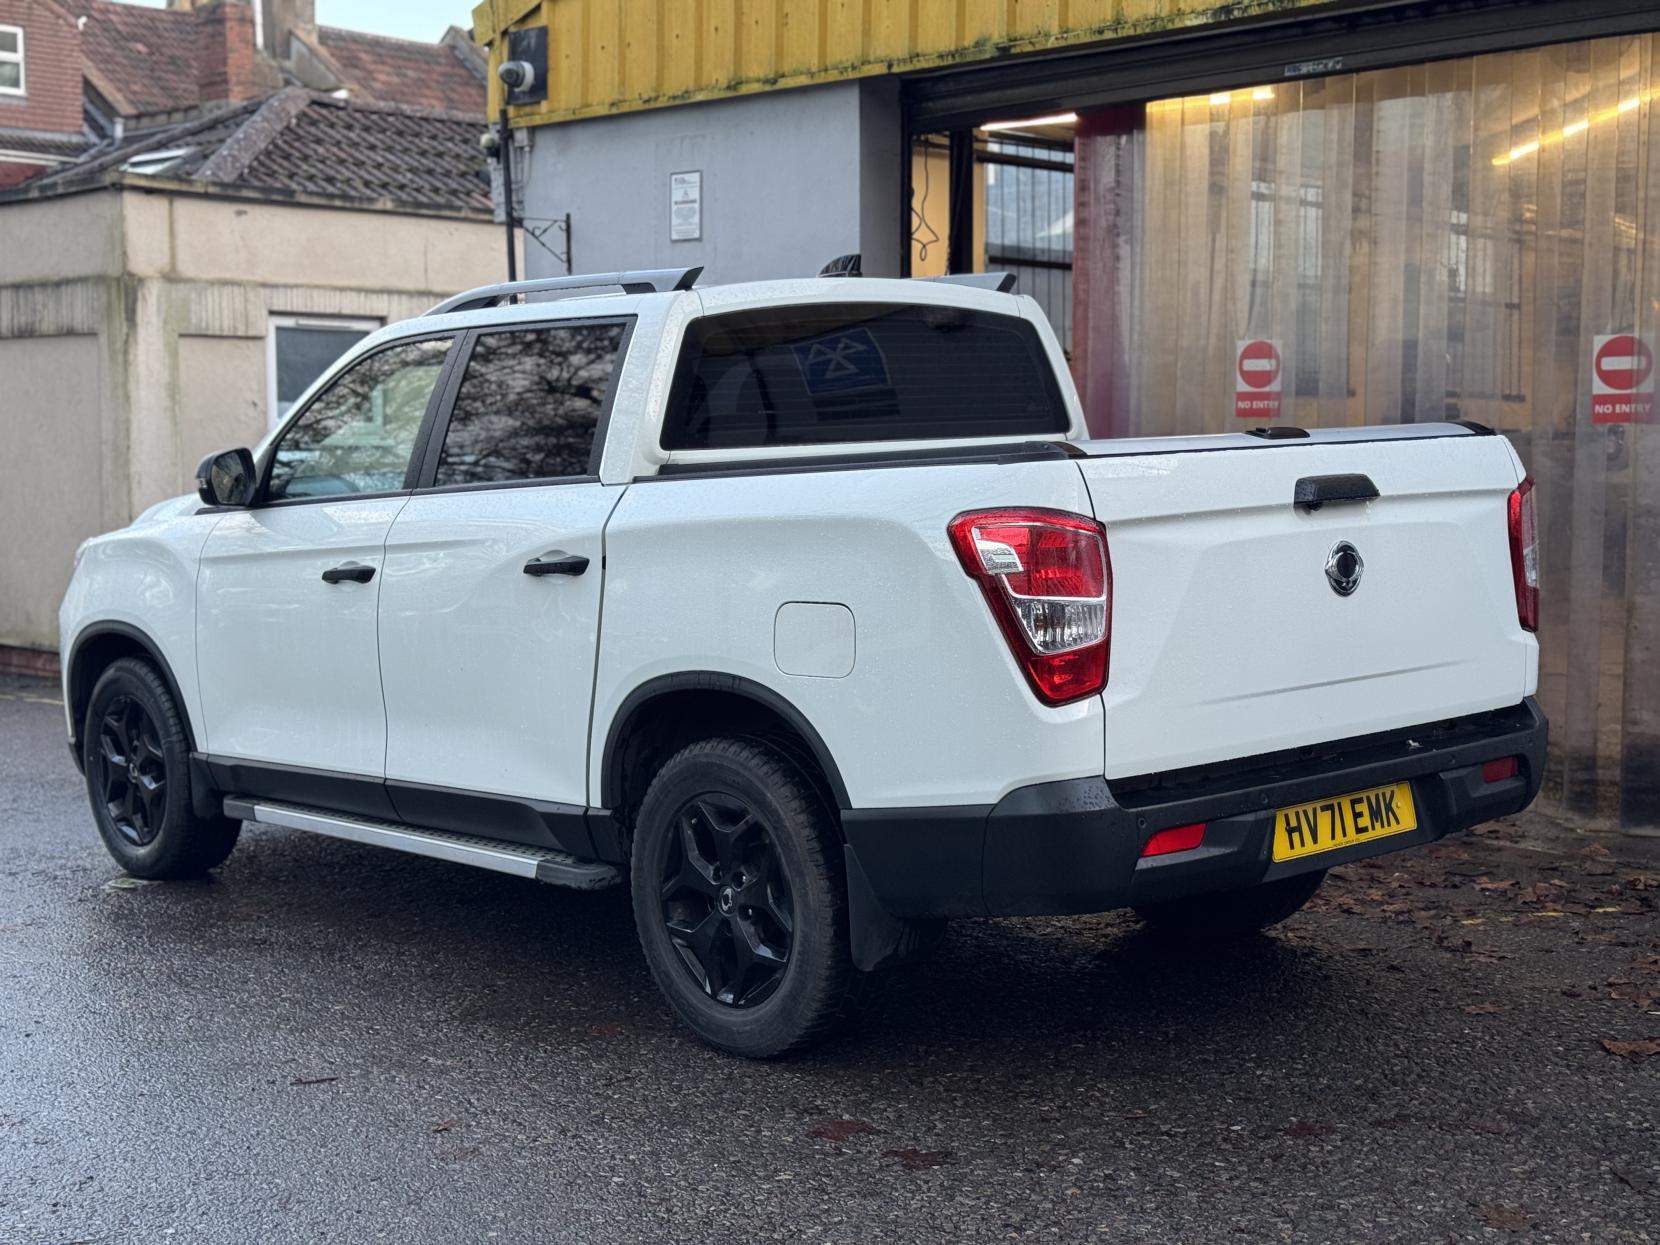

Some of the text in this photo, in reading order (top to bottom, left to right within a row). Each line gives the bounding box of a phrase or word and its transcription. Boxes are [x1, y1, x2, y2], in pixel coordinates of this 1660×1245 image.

[1237, 400, 1280, 409] NO ENTRY
[1594, 403, 1652, 414] NO ENTRY
